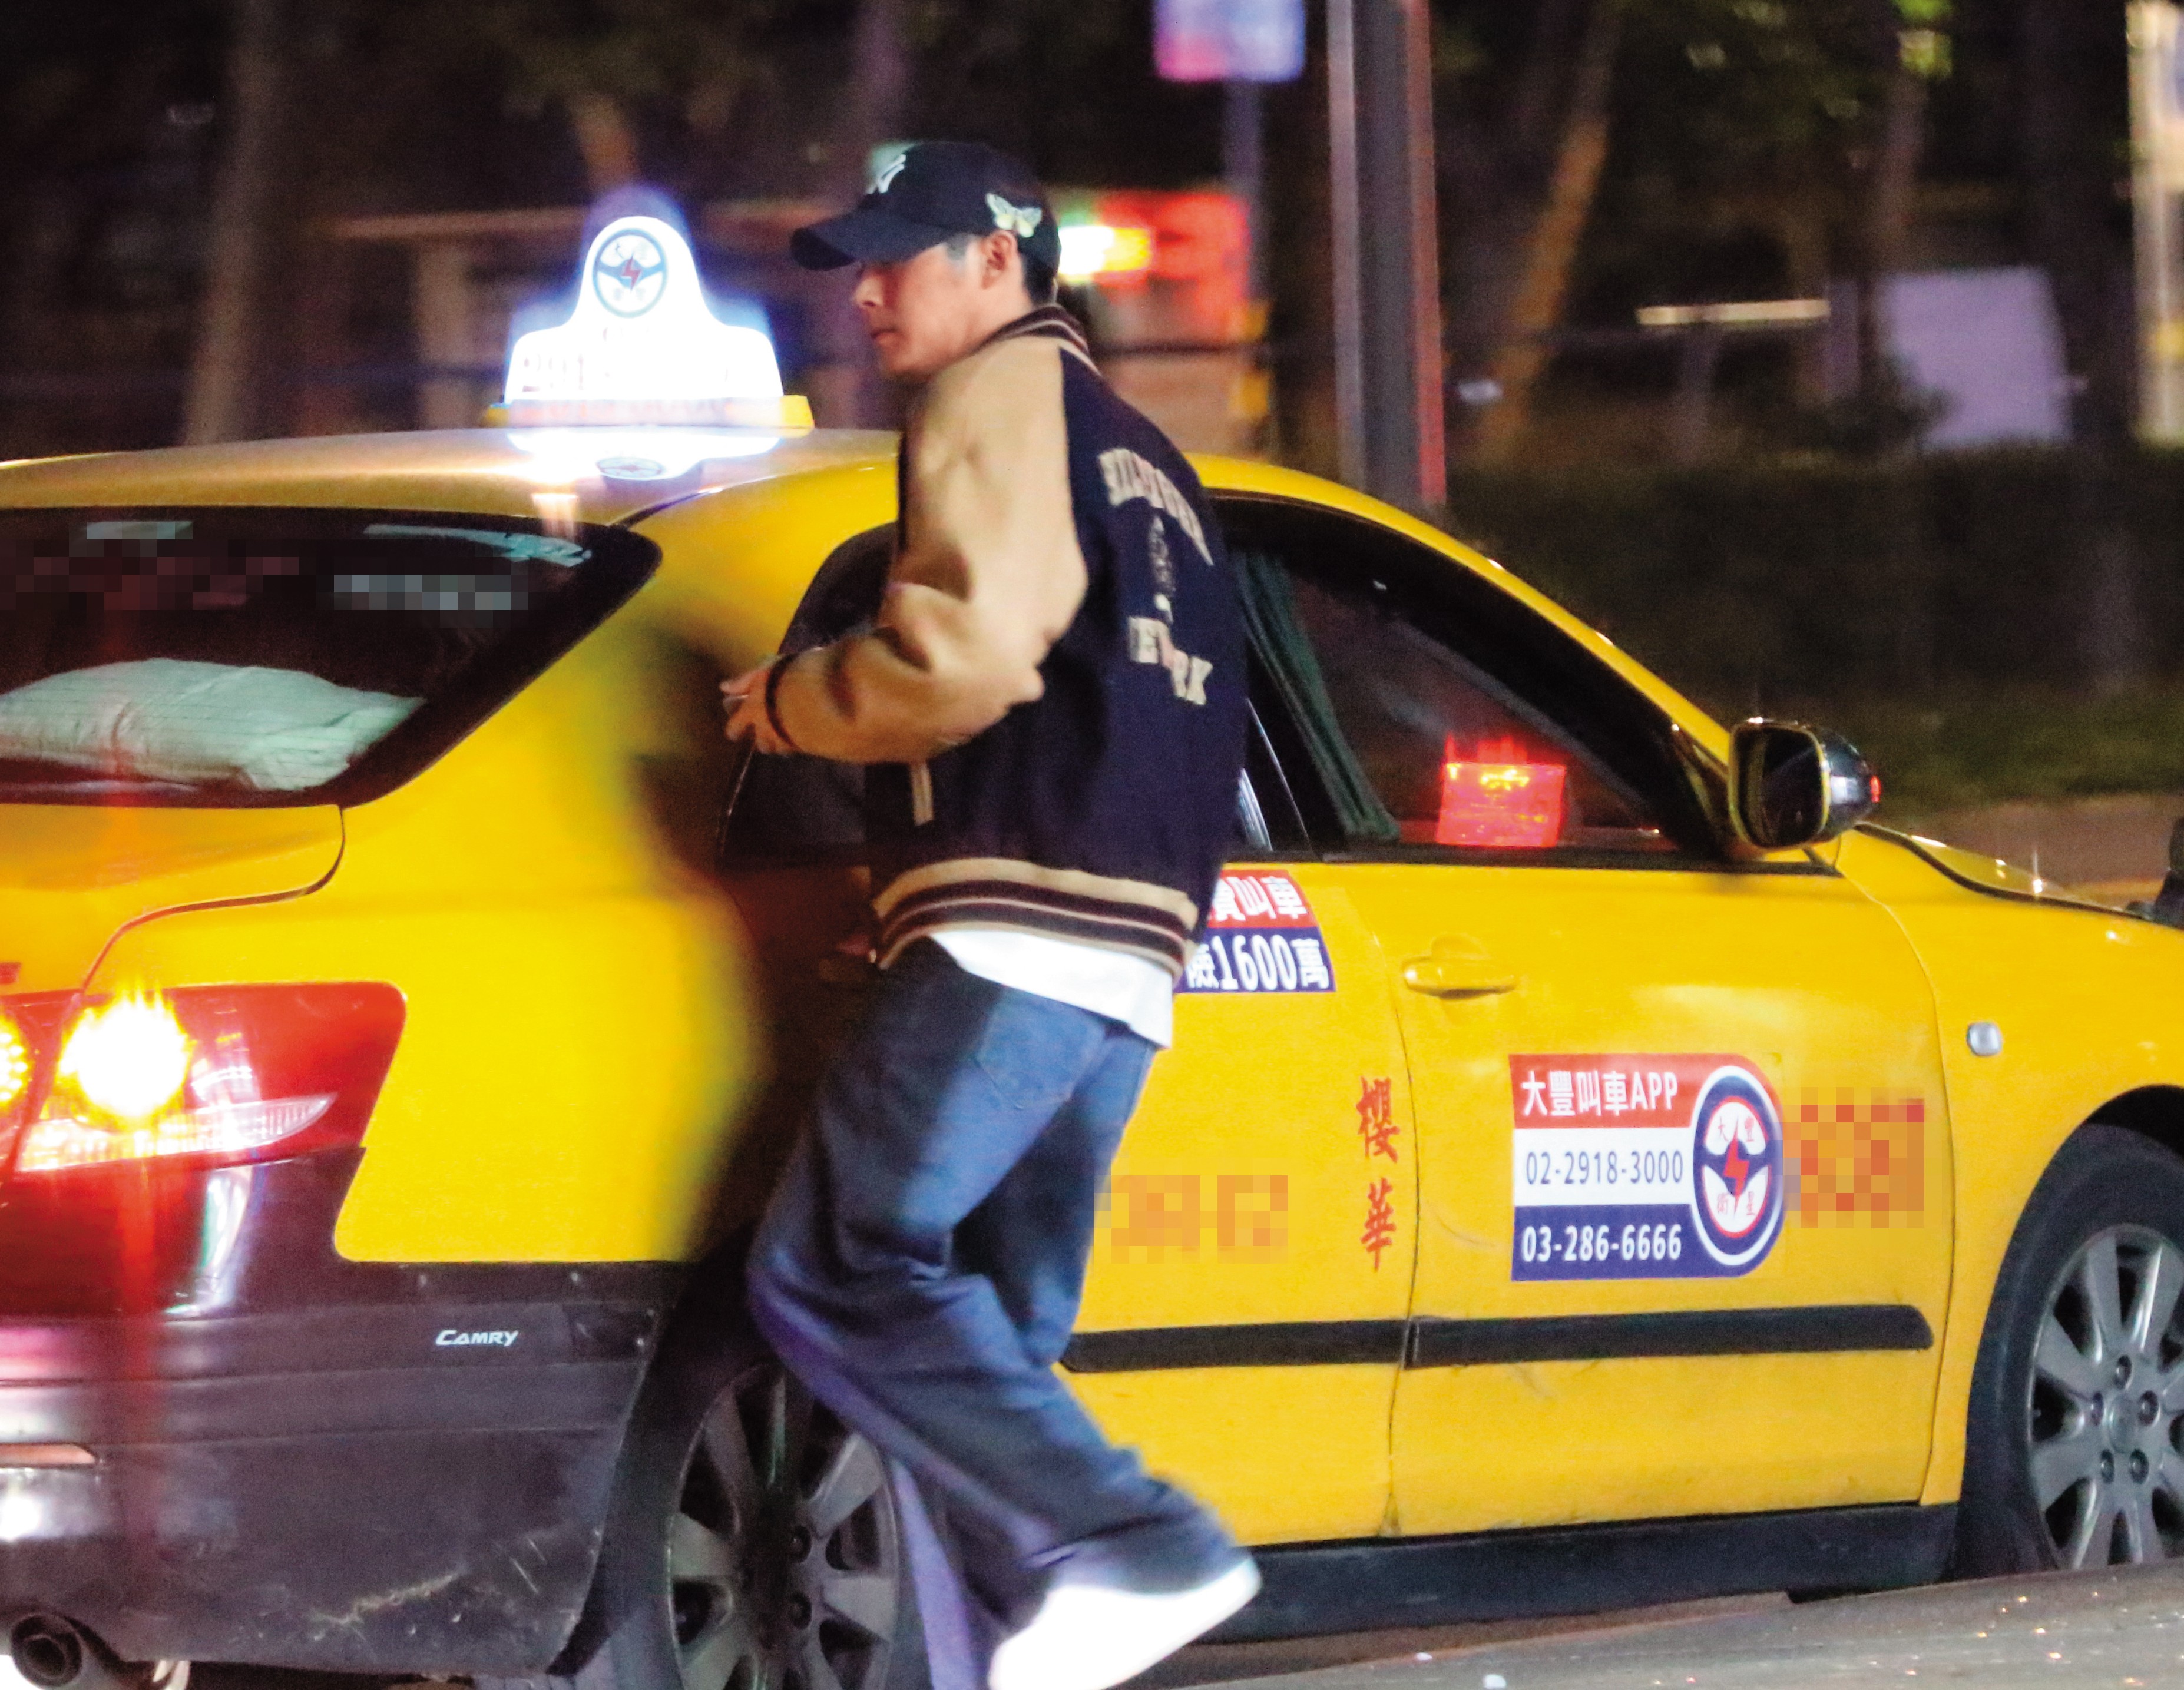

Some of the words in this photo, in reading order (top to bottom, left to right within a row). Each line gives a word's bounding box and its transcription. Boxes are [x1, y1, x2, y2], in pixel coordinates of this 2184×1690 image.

[1521, 1070, 1677, 1116] 大豐叫車APP
[1526, 1150, 1683, 1185] 02-2918-3000
[1521, 1224, 1682, 1262] 03-286-6666
[435, 1330, 519, 1346] CAMRY
